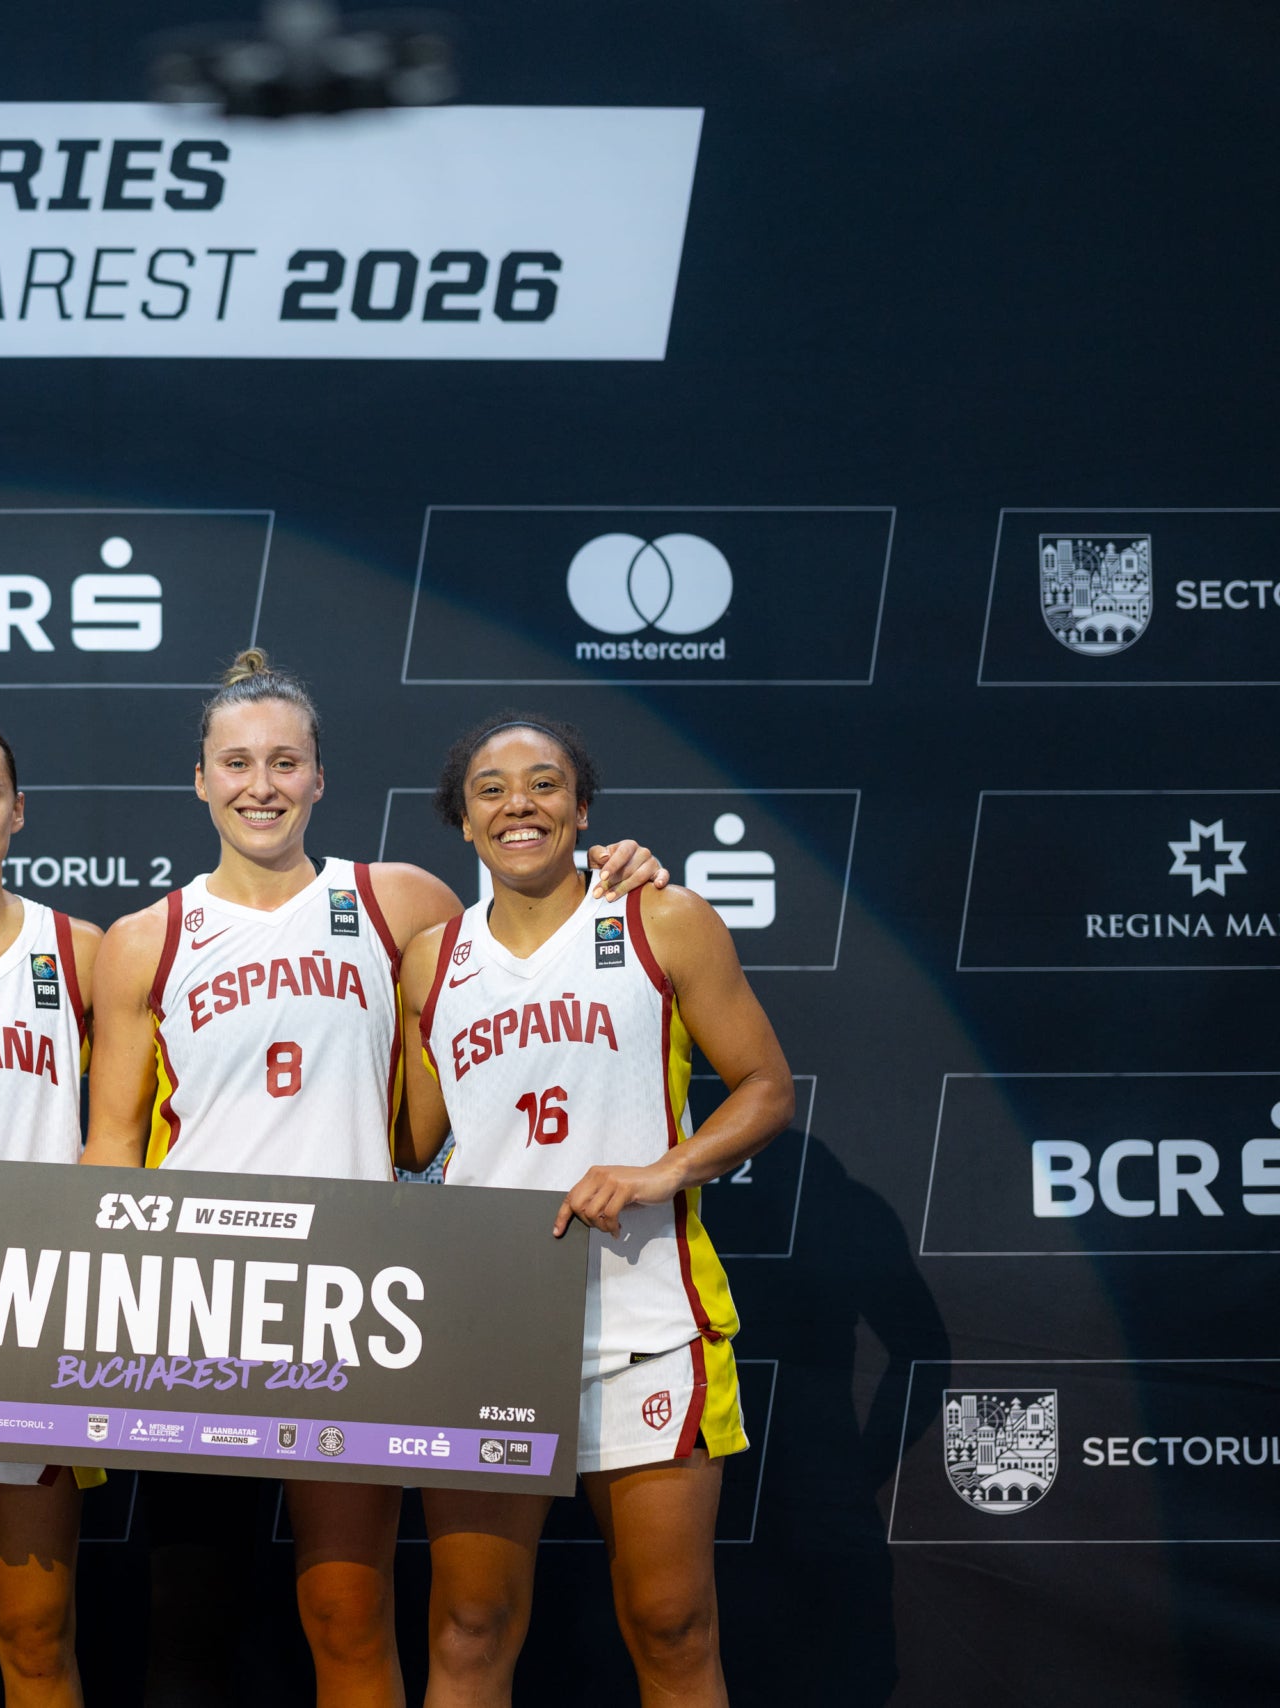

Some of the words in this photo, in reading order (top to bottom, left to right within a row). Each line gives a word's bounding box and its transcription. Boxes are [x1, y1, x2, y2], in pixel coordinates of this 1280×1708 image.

[279, 249, 563, 323] 2026
[1176, 579, 1280, 609] SECT
[576, 637, 726, 661] mastercard
[1, 857, 140, 887] TORUL
[149, 857, 172, 887] 2
[334, 914, 355, 924] FIBA
[1086, 913, 1216, 938] REGINA
[1225, 913, 1280, 937] MA
[599, 944, 620, 955] FIBA
[37, 984, 56, 995] FIBA
[187, 950, 368, 1034] ESPAÑA
[451, 992, 619, 1082] ESPAÑA
[266, 1041, 302, 1098] 8
[515, 1085, 569, 1149] 16
[1032, 1138, 1225, 1217] BCR
[194, 1208, 215, 1225] W
[218, 1208, 298, 1229] SERIES
[51, 1355, 264, 1393] BUCHAREST
[264, 1358, 349, 1392] 2026
[48, 1421, 55, 1430] 2
[478, 1406, 536, 1423] #3x3WS
[203, 1426, 257, 1436] ULAANBAATAR
[211, 1435, 249, 1444] AMAZONS
[388, 1437, 428, 1456] BCR
[510, 1443, 528, 1453] FIBA
